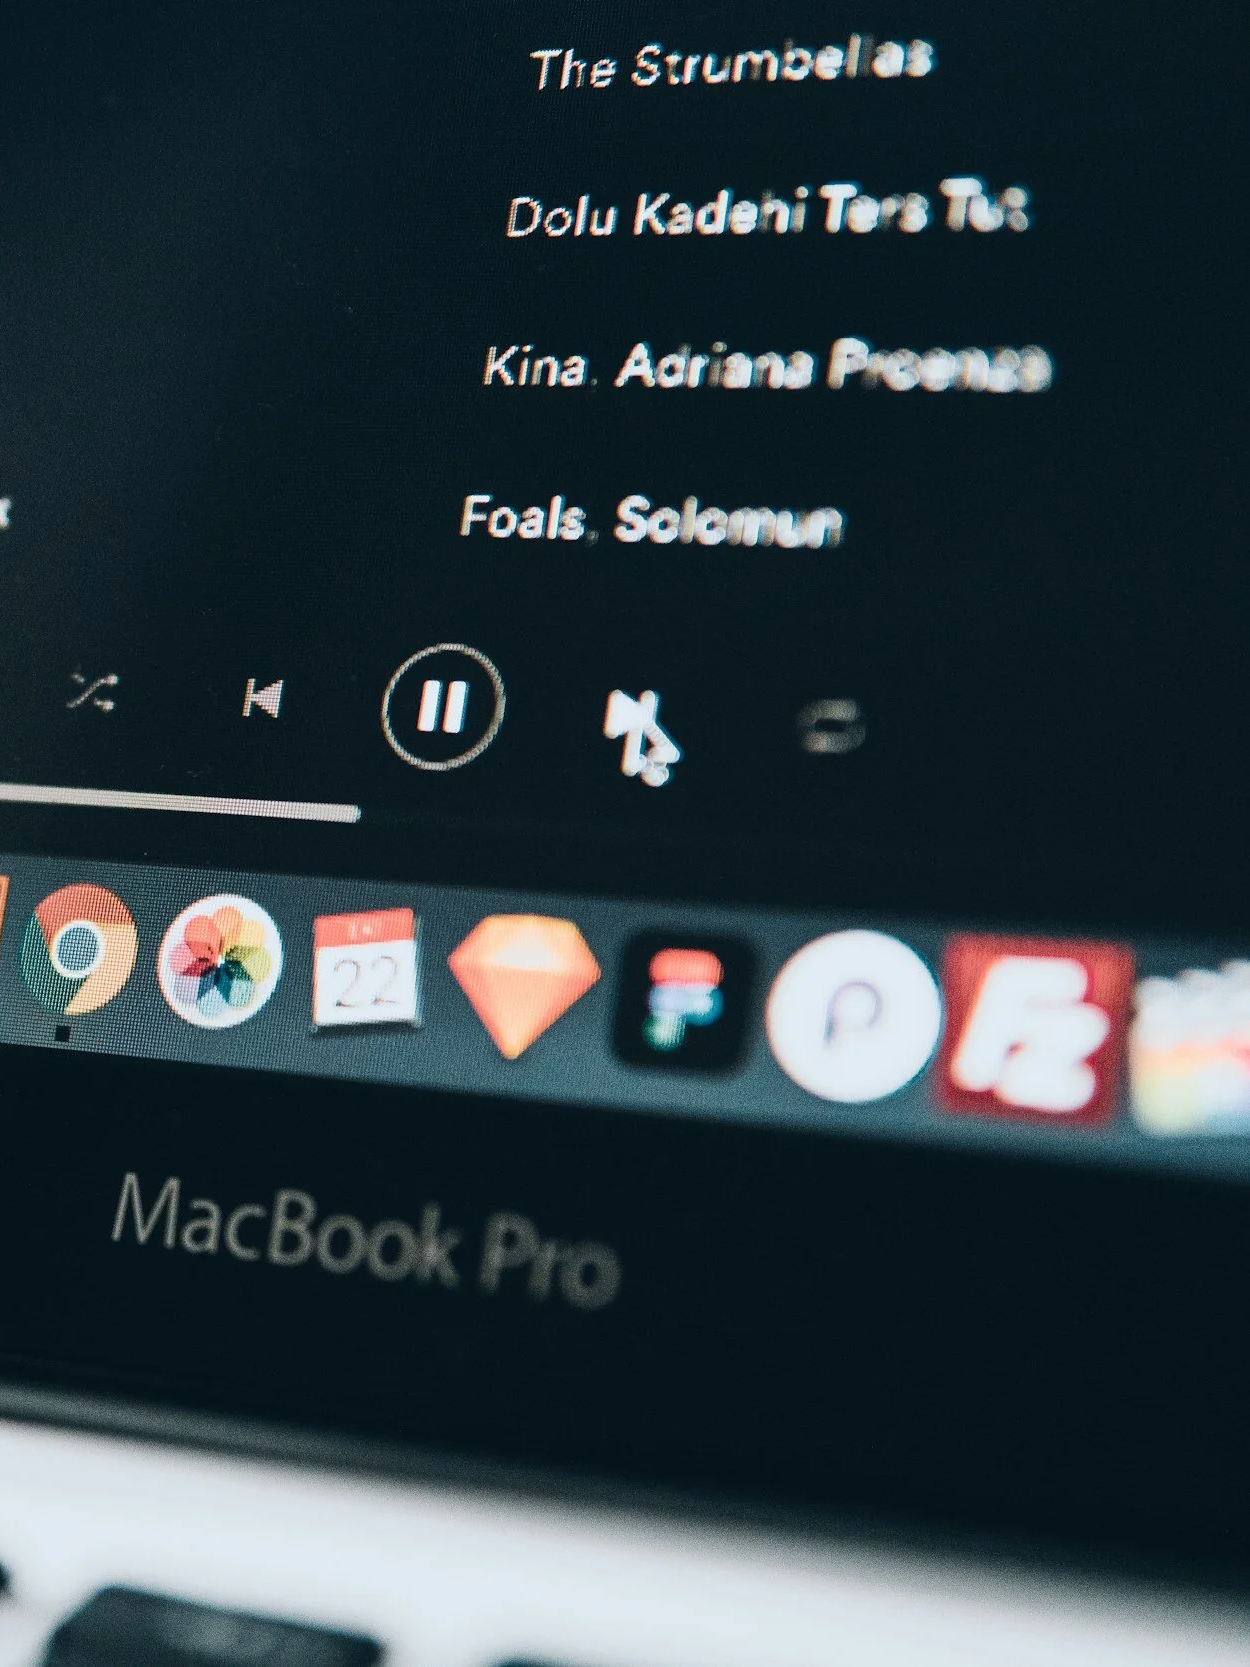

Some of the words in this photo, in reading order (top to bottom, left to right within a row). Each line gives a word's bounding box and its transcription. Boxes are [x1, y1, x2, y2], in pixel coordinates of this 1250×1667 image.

[529, 48, 618, 91] The
[505, 193, 619, 238] Dolu
[613, 340, 817, 391] Adriana
[333, 955, 399, 1009] 22
[110, 1170, 462, 1289] MacBook
[478, 1210, 623, 1311] Pro
